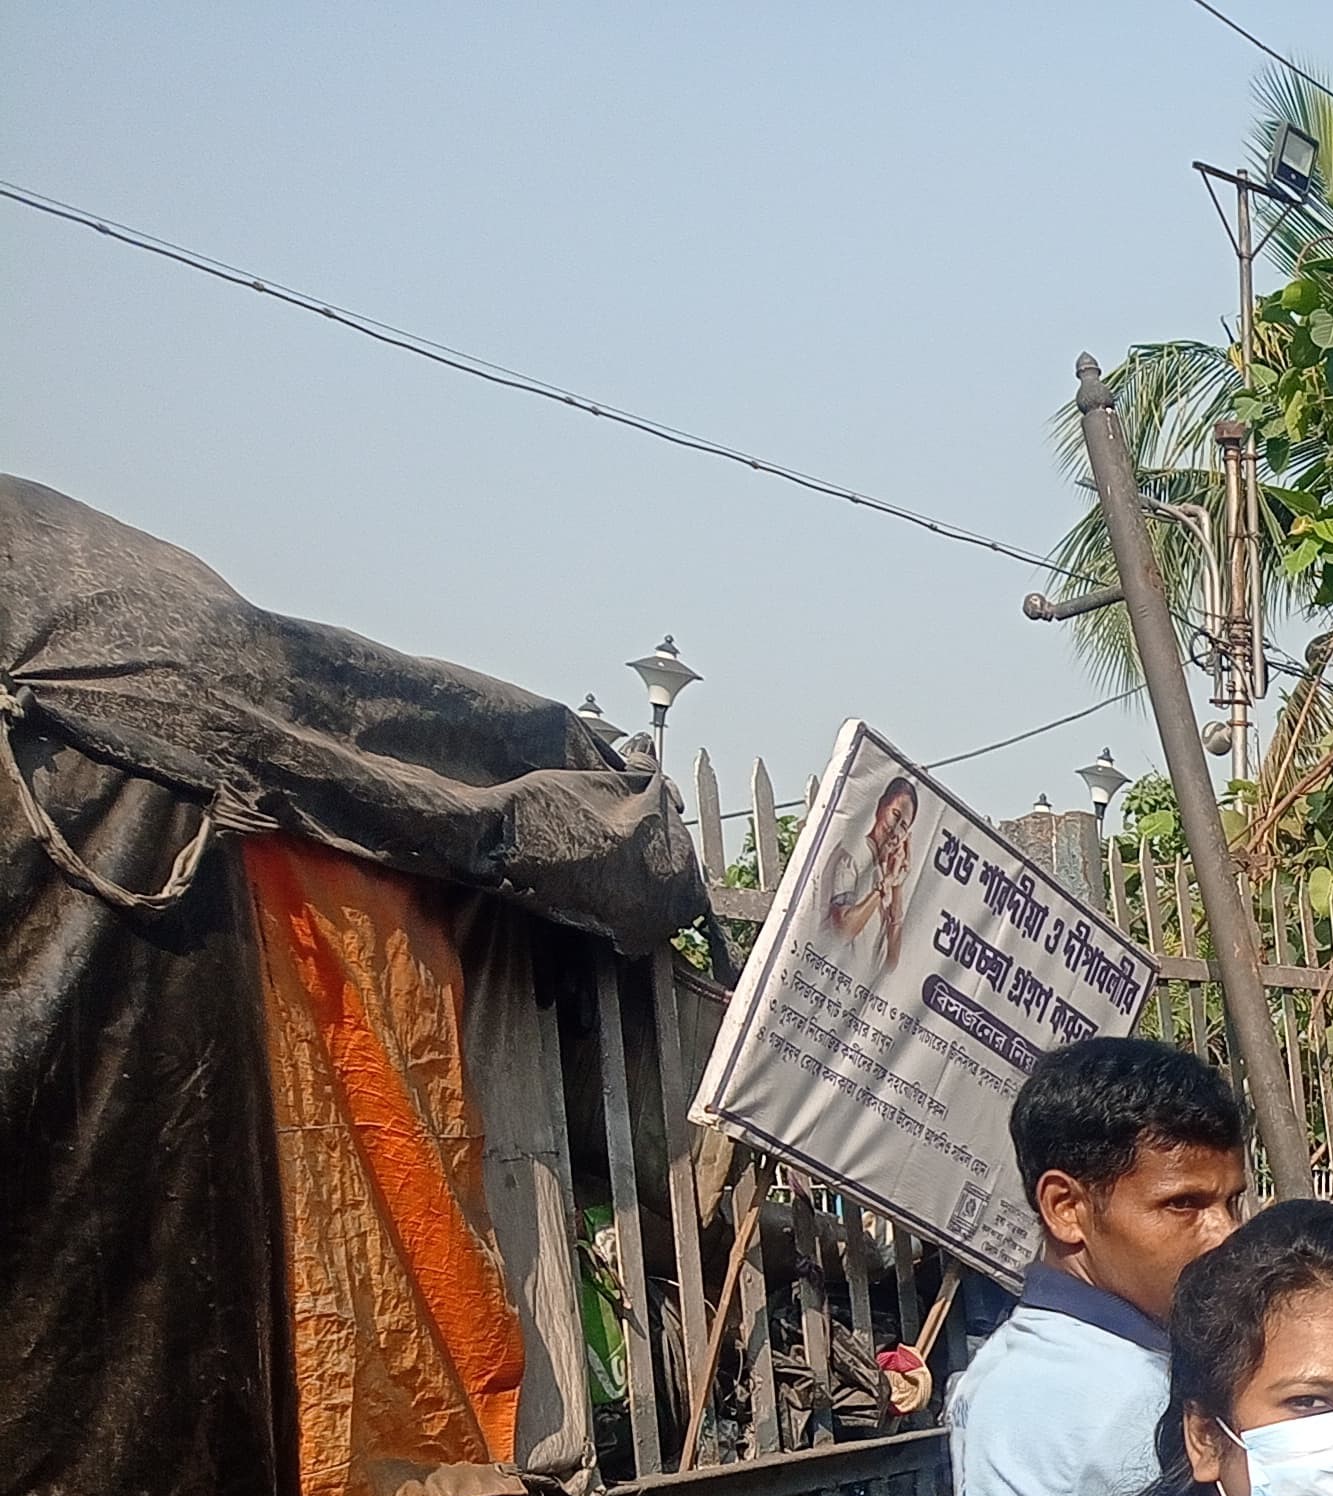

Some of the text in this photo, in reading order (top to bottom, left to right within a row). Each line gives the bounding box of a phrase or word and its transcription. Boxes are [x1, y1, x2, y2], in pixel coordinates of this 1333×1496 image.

[933, 828, 980, 886] শুভ
[979, 860, 1049, 943] শারদীয়া
[1044, 918, 1065, 954] ও
[931, 981, 1008, 1050] বিসর্জনের
[933, 909, 1014, 994] শুভেচ্ছা
[1007, 966, 1053, 1023] গ্রহণ
